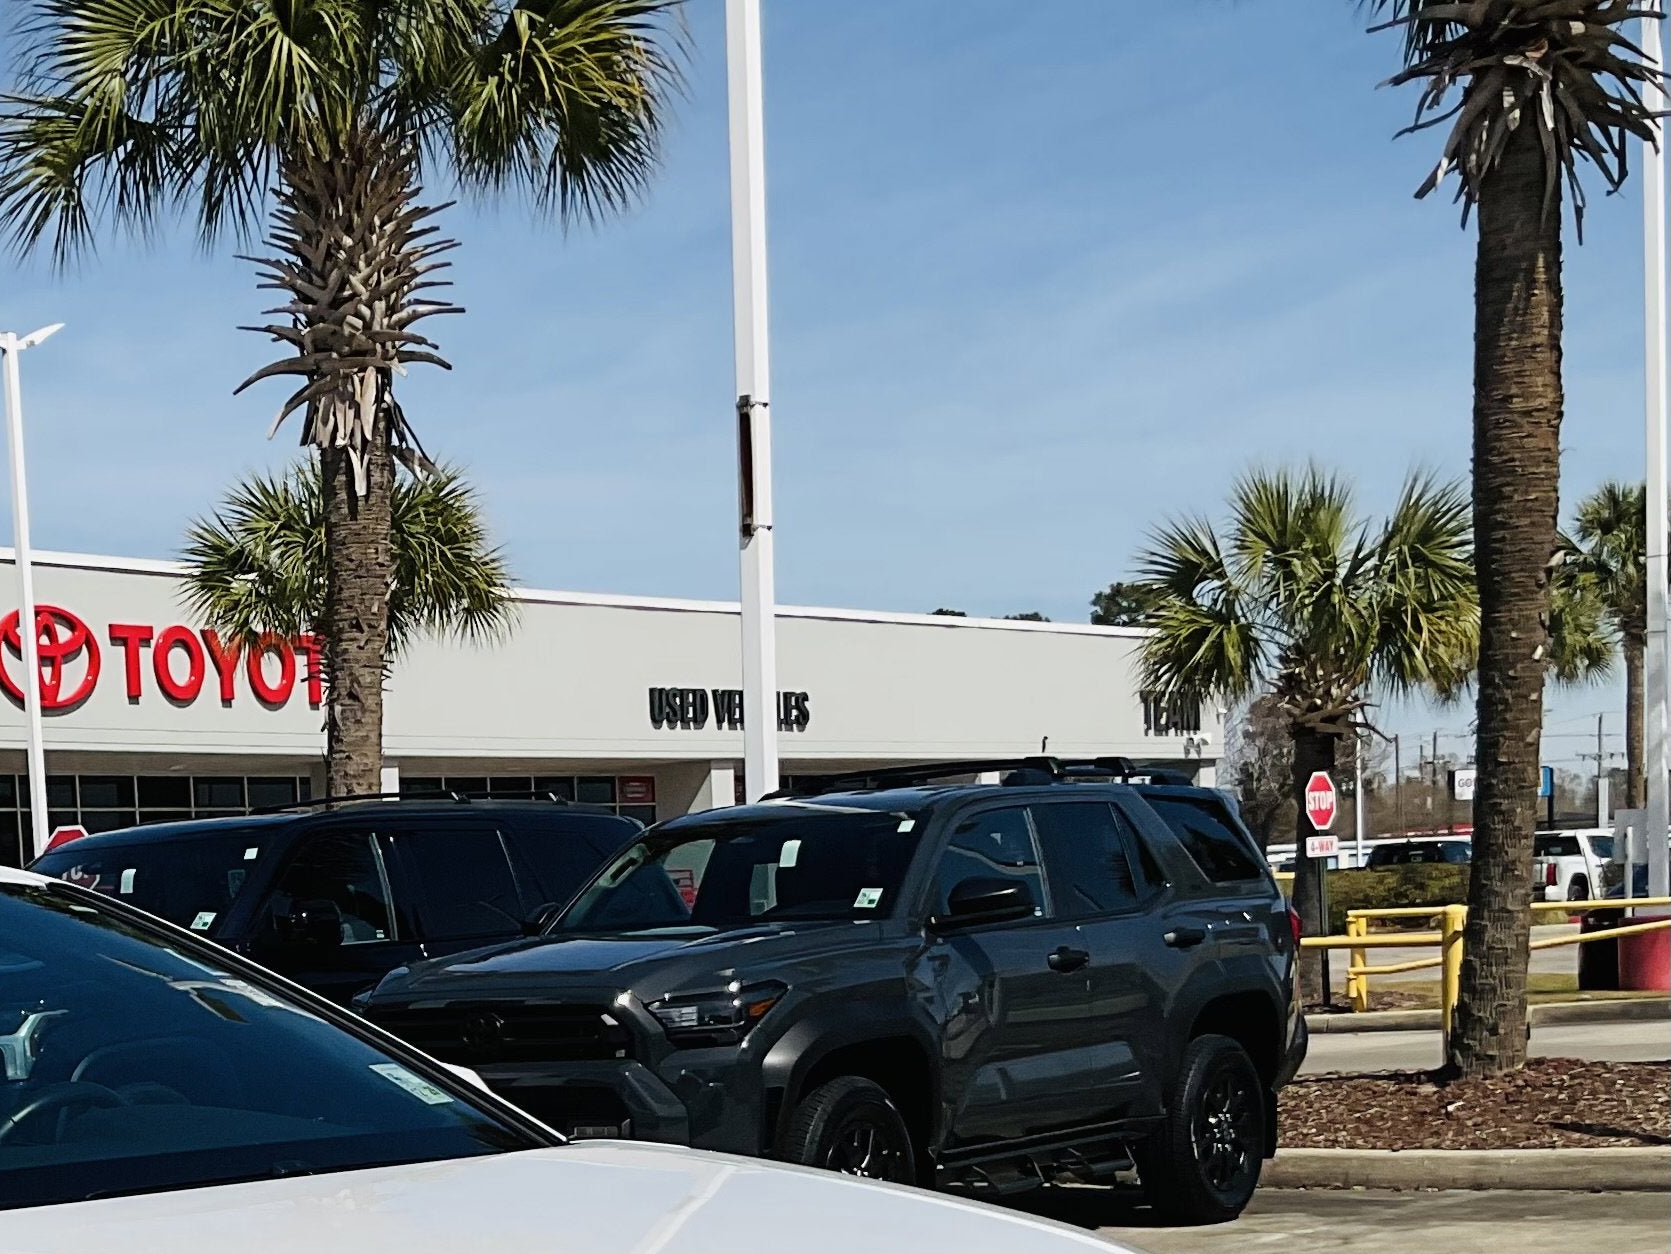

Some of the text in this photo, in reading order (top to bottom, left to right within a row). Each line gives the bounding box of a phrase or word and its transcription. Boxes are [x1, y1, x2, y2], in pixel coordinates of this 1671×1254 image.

[108, 623, 325, 704] TOYOT
[648, 687, 810, 728] USED VELES
[1308, 791, 1333, 811] STOP
[1310, 840, 1334, 853] 4-WAY
